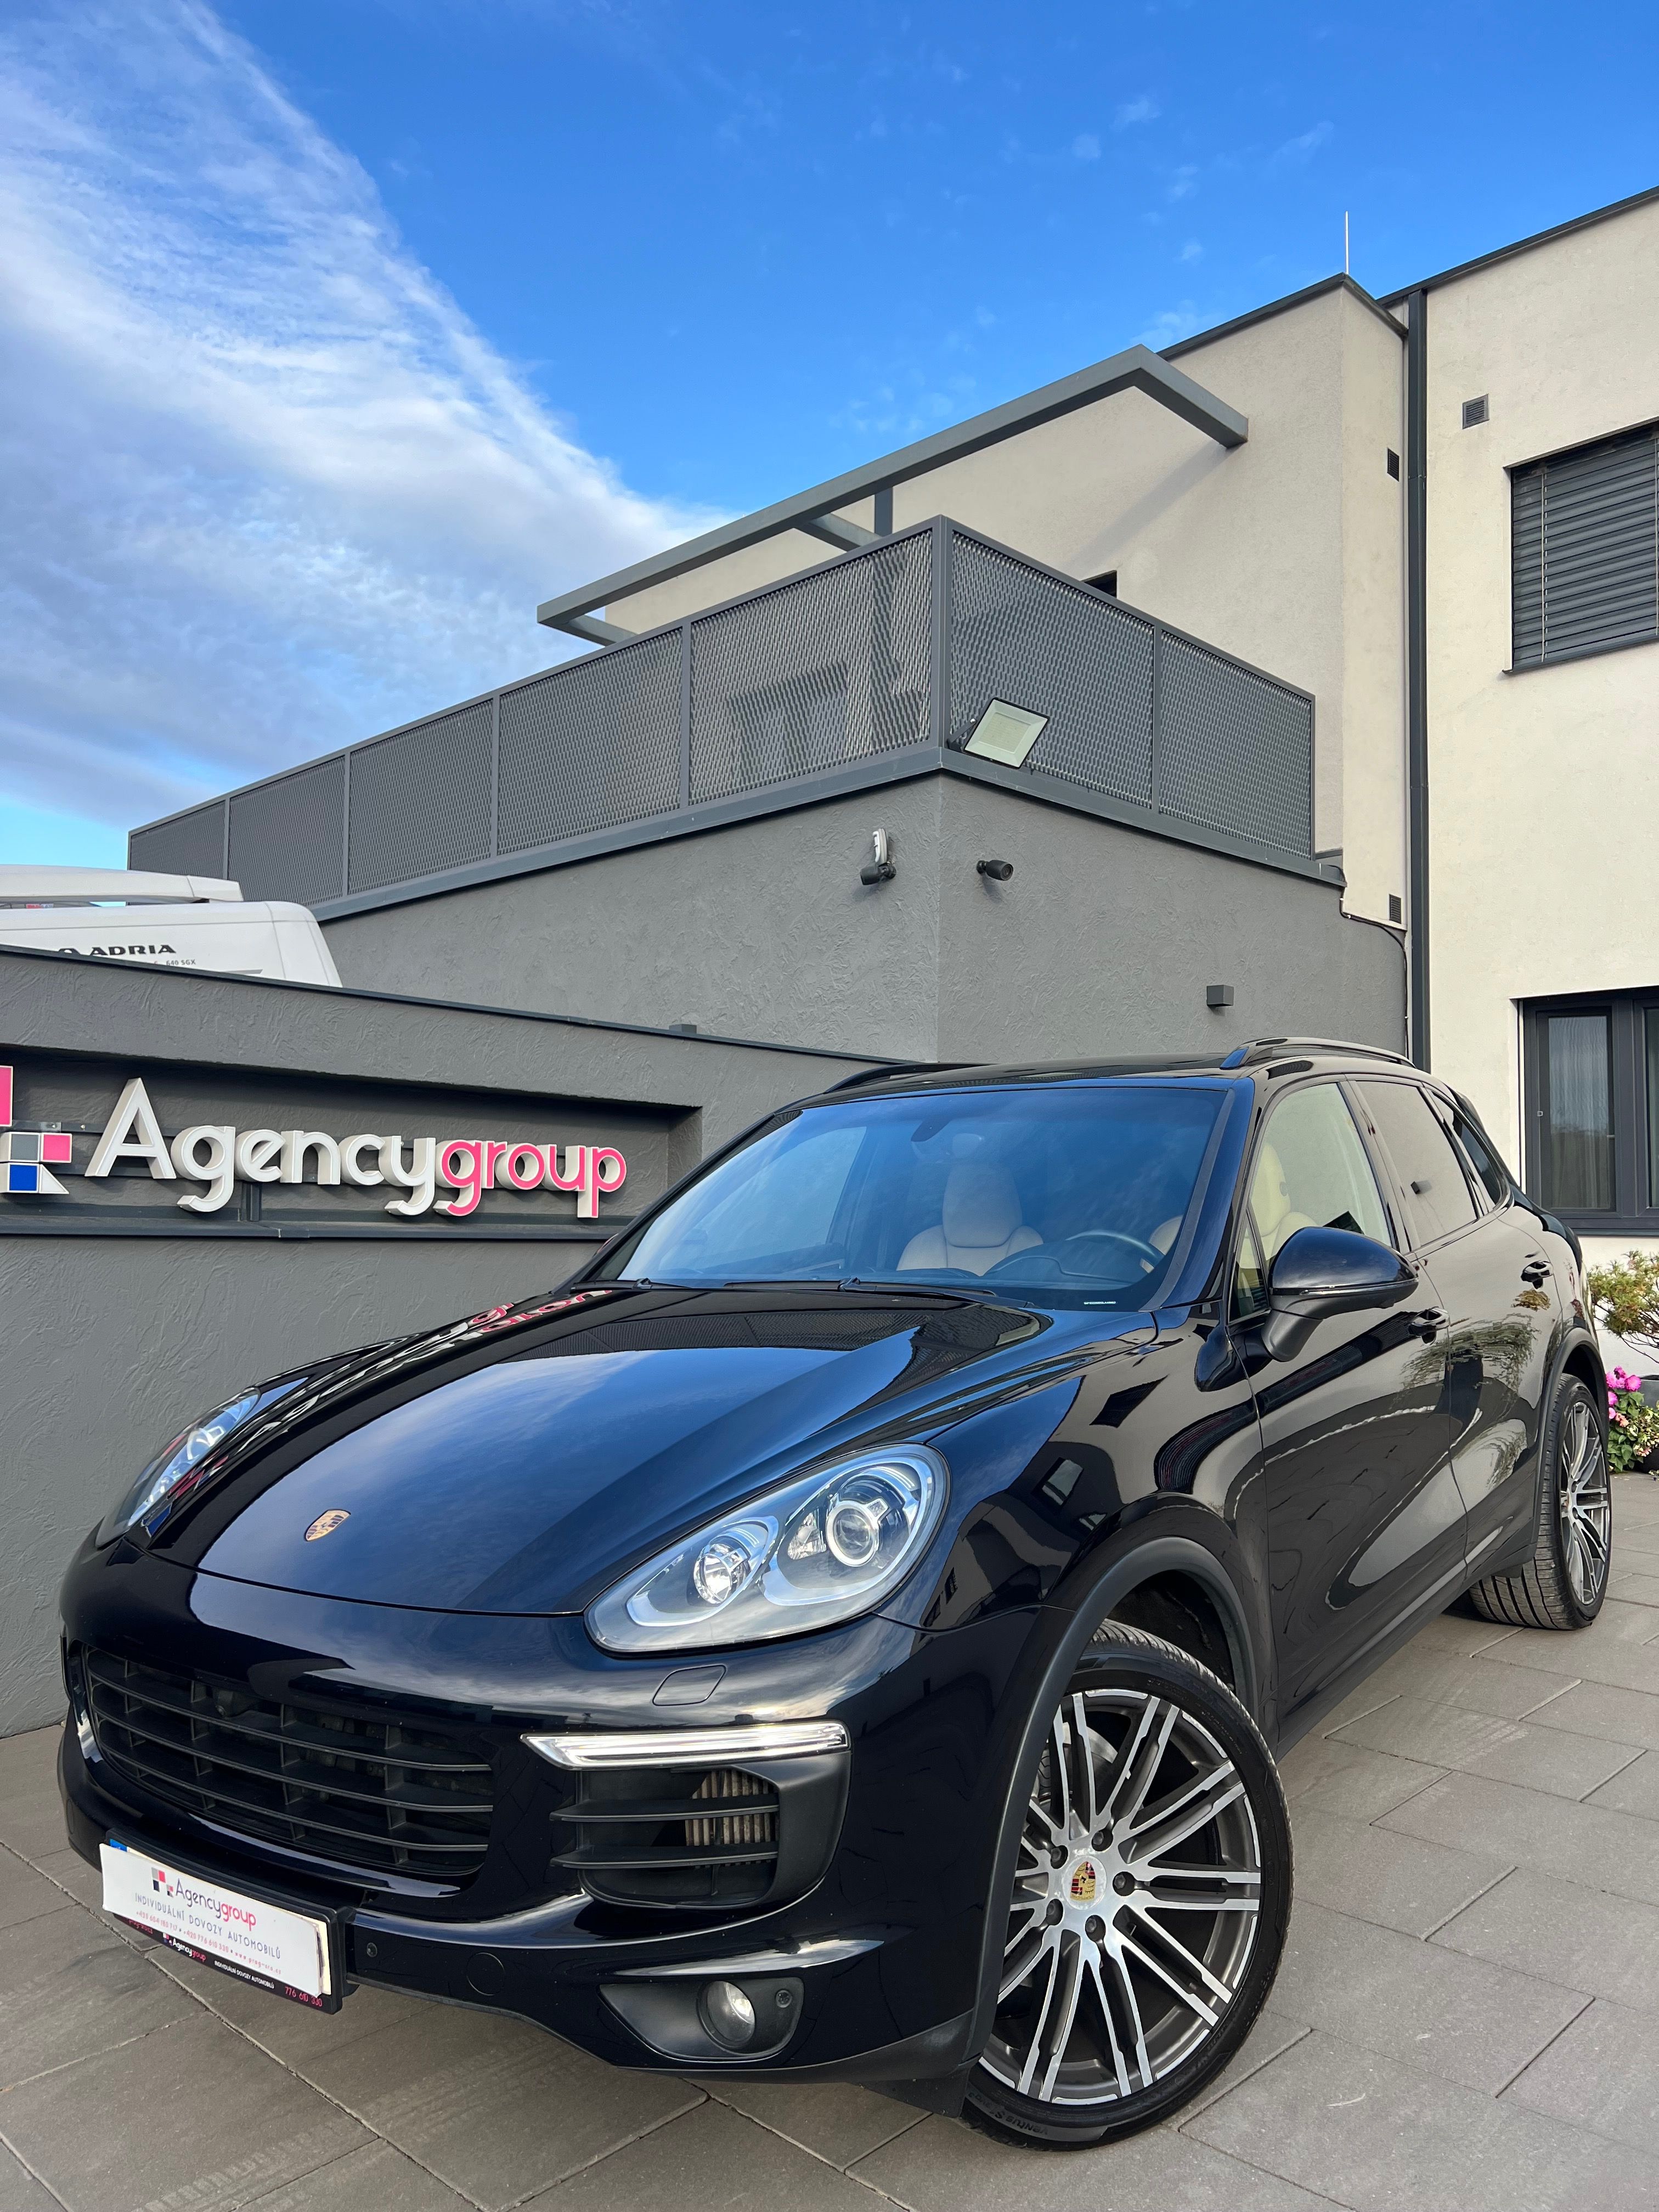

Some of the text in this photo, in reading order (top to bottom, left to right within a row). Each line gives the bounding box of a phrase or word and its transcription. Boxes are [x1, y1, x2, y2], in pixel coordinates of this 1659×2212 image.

[89, 945, 177, 956] ADRIA
[84, 1077, 628, 1218] Agencygroup
[176, 1878, 257, 1931] Agencygroup
[189, 1915, 223, 1936] DOVOZY
[228, 1931, 281, 1960] AUTOMOBILŮ
[285, 1986, 297, 1997] 776
